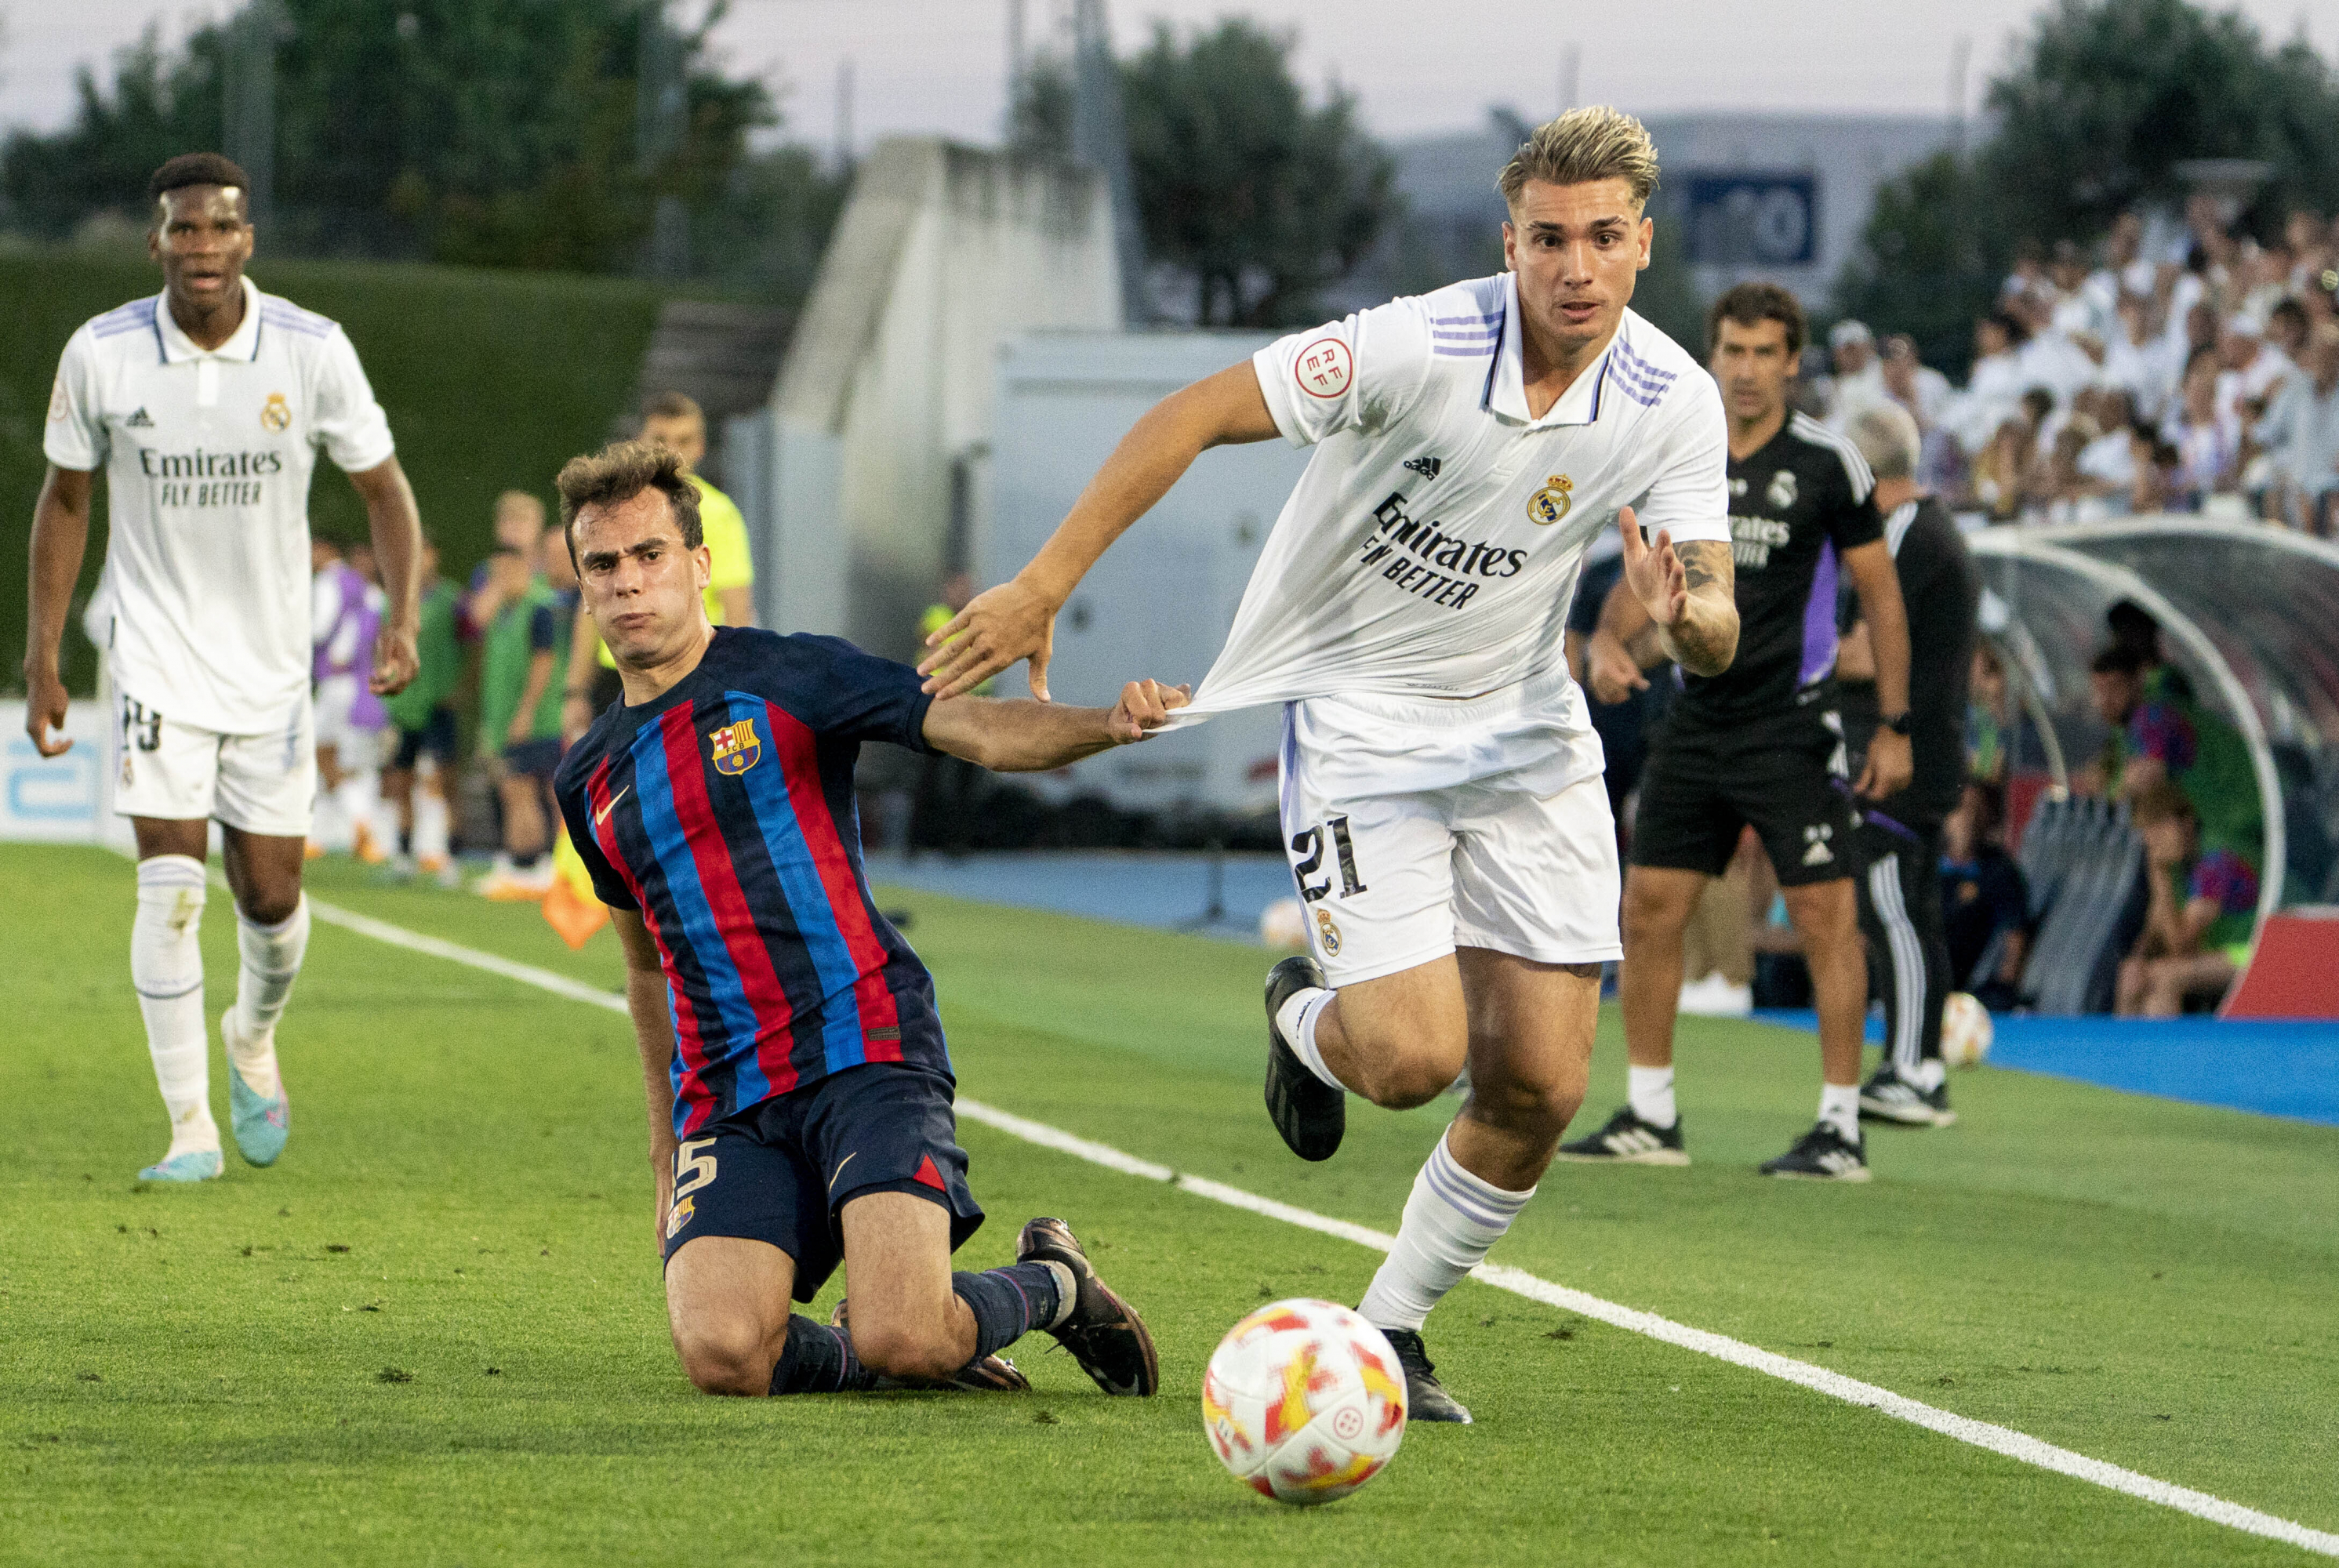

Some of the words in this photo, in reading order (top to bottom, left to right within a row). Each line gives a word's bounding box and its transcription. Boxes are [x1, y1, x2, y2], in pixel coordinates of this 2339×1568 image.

[139, 447, 281, 477] Emirates
[162, 483, 191, 506] FLY
[198, 481, 262, 506] BETTER
[1372, 491, 1528, 578] Emirates
[1382, 556, 1480, 610] BETTER
[726, 742, 745, 754] FCB
[1291, 815, 1368, 904] 21
[670, 1137, 717, 1202] 5
